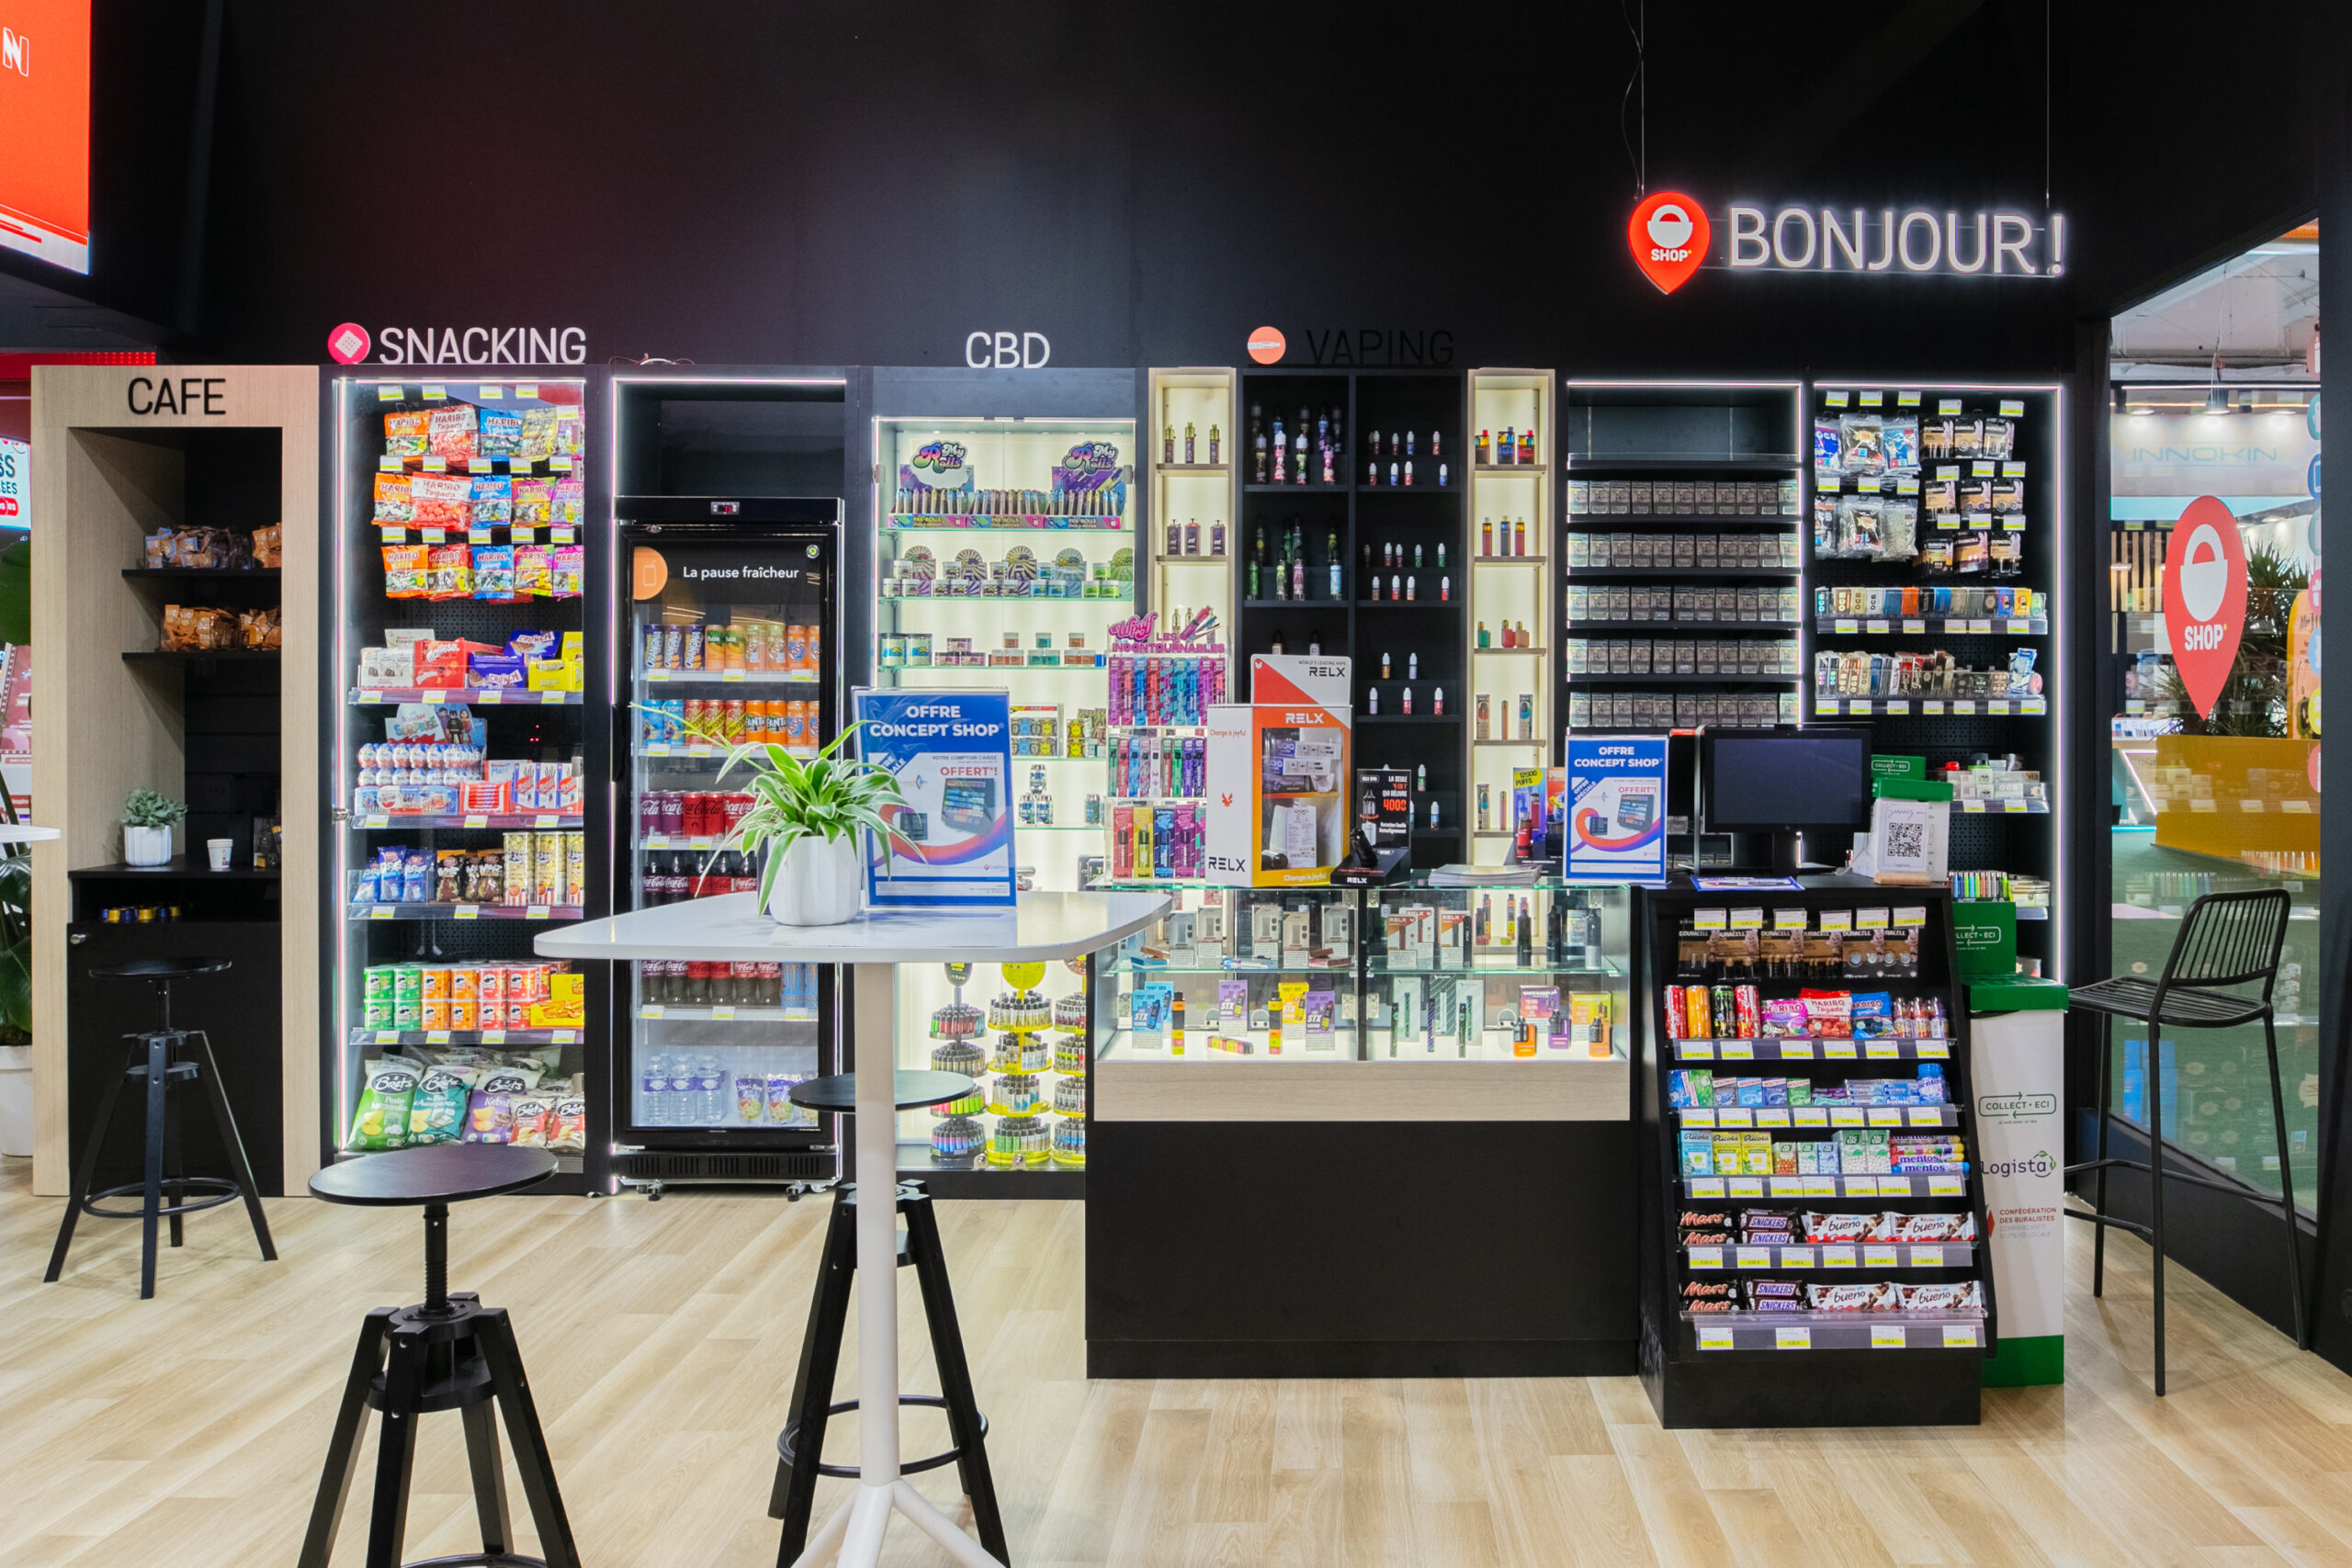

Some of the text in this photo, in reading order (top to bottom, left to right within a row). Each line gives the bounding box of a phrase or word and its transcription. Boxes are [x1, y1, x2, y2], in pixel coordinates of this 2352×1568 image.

[1728, 206, 2036, 275] BONJOUR
[1651, 247, 1689, 263] SHOP
[379, 326, 587, 365] SNACKING
[966, 332, 1050, 368] CBD
[1306, 328, 1454, 366] VAPING
[127, 378, 226, 415] CAFE
[435, 413, 466, 423] HARIBO
[2132, 447, 2278, 462] INNOKIN
[474, 482, 503, 491] HARIBO
[518, 485, 548, 493] HARIBO
[477, 552, 507, 561] HARIBO
[684, 566, 799, 581] La pause fraîcheur
[2184, 624, 2224, 651] SHOP
[1112, 643, 1225, 653] INCONTOURNABLES
[1309, 667, 1345, 677] RELX
[906, 705, 961, 717] OFFRE
[1285, 713, 1324, 724] RELX
[870, 724, 999, 737] CONCEPT SHOP
[1233, 729, 1246, 738] joyful
[1599, 747, 1634, 755] OFFRE
[1574, 759, 1658, 767] CONCEPT SHOP
[1208, 856, 1246, 872] RELX
[1283, 874, 1306, 882] Change
[1761, 1003, 1802, 1013] HARIBO
[1985, 1100, 2050, 1110] COLLECT ECI
[1899, 1155, 1939, 1163] mentos
[1905, 1164, 1945, 1172] mentos
[1981, 1158, 2047, 1178] Logista
[1999, 1207, 2056, 1215] CONFÉDÉRATION
[1679, 1212, 1724, 1226] Mars
[1751, 1217, 1786, 1227] SNICKERS
[1828, 1220, 1860, 1232] bueno
[1913, 1222, 1945, 1233] bueno
[1683, 1232, 1726, 1246] Mars
[1752, 1234, 1788, 1243] SNICKERS
[1683, 1281, 1728, 1296] Mars
[1758, 1284, 1794, 1294] SNICKERS
[1834, 1291, 1865, 1303] bueno
[1919, 1292, 1951, 1303] bueno
[1688, 1300, 1731, 1312] Mars
[1759, 1302, 1796, 1311] SNICKERS
